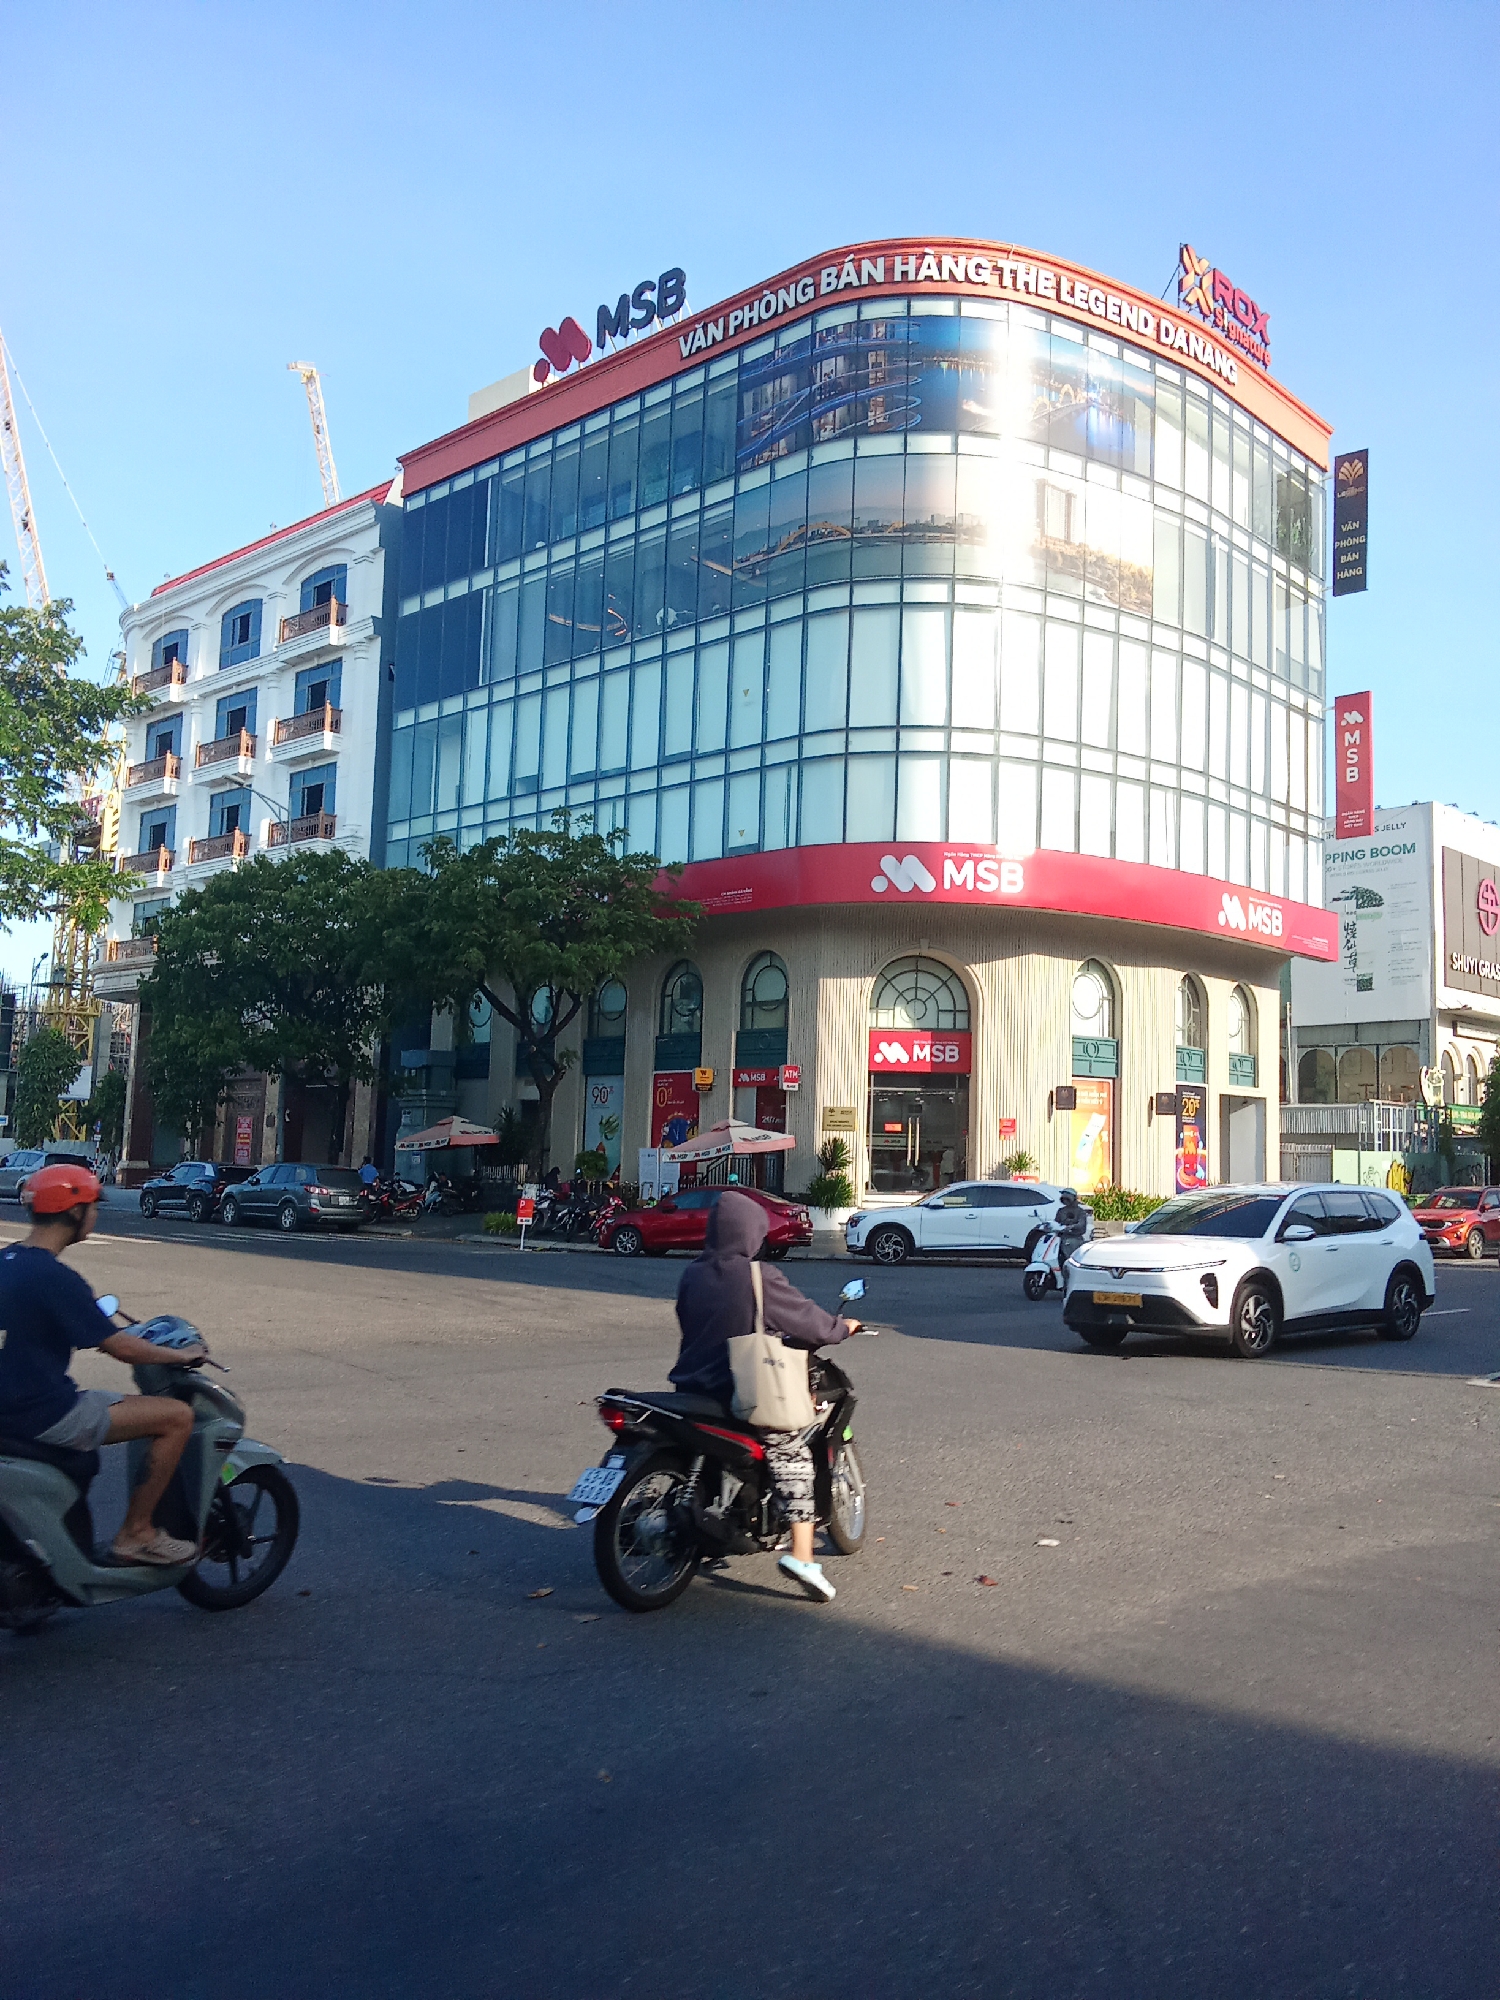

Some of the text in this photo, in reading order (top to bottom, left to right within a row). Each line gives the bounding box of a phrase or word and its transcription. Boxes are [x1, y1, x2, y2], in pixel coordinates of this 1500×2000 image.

[596, 267, 686, 350] MSB
[1213, 268, 1270, 345] ROX
[679, 248, 1239, 386] VĂN PHÒNG BÁN HÀNG THE LEGEND DANANG
[1213, 307, 1271, 366] signature
[1340, 520, 1360, 533] VĂN
[1335, 535, 1366, 550] PHÒNG
[1340, 551, 1359, 564] BÁN
[1337, 566, 1363, 580] HÀNG
[1381, 821, 1407, 832] JELLY
[1370, 842, 1416, 859] BOOM
[943, 859, 1024, 894] MSB
[1248, 902, 1283, 937] MSB
[1451, 952, 1478, 975] SHUYI
[912, 1044, 960, 1063] MSB
[750, 1073, 766, 1082] MSB
[784, 1070, 798, 1079] ATM
[520, 1200, 526, 1209] P
